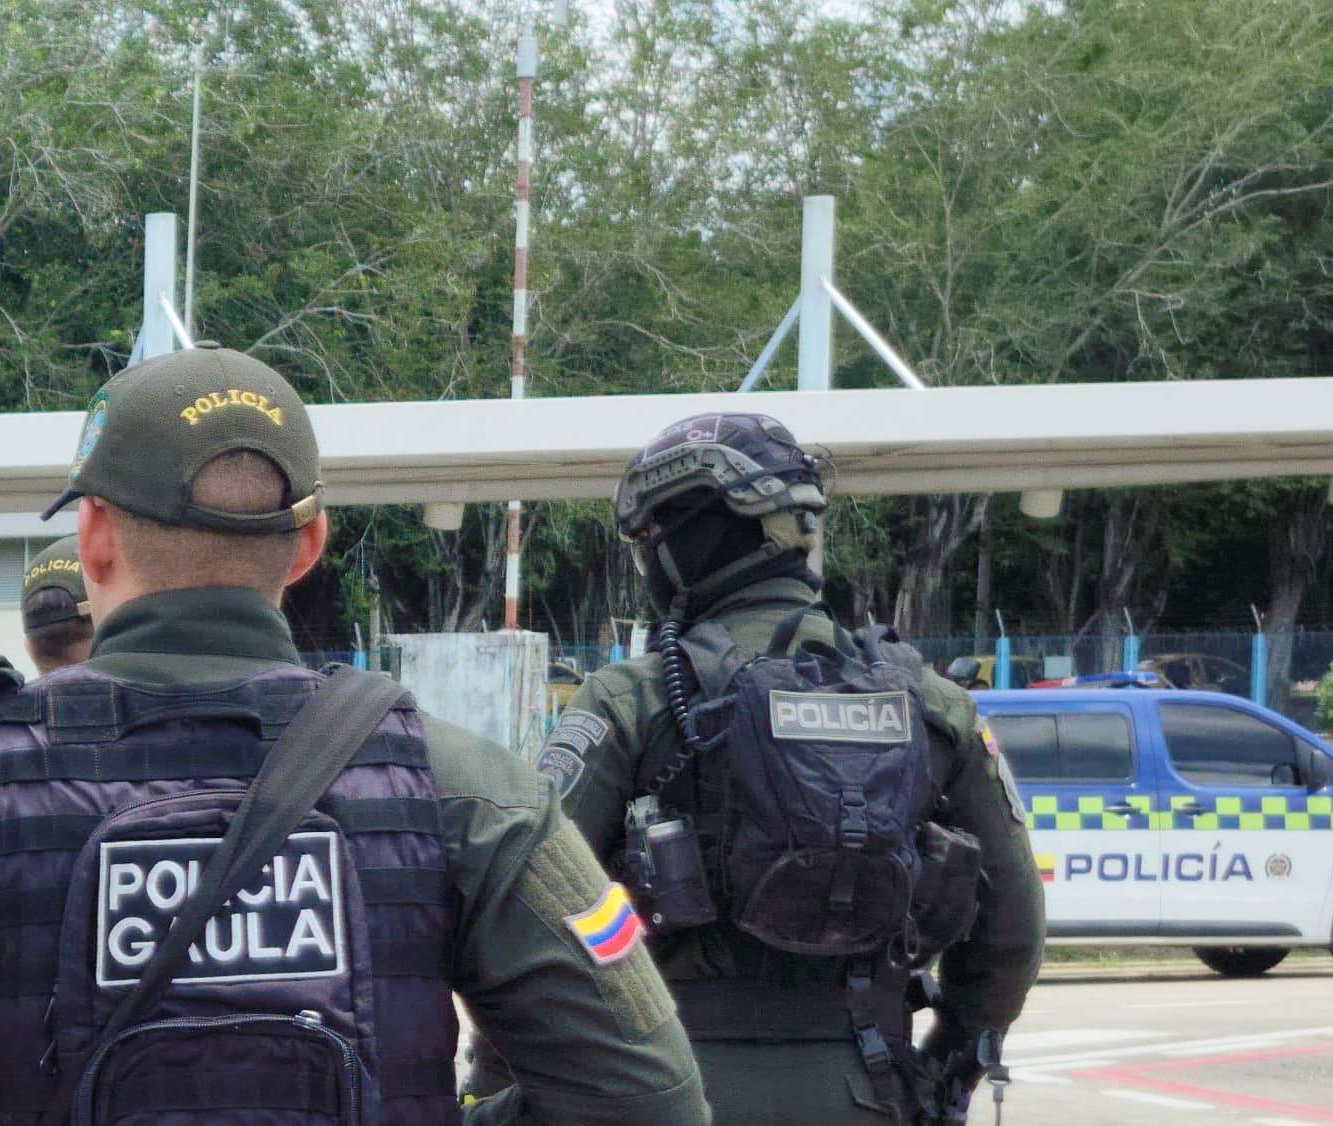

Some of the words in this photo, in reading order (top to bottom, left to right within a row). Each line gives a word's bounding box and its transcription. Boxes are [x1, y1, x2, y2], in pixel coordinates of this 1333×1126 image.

[179, 389, 284, 426] POLICIA
[776, 698, 903, 731] POLICÍA
[1065, 840, 1253, 882] POLICÍA
